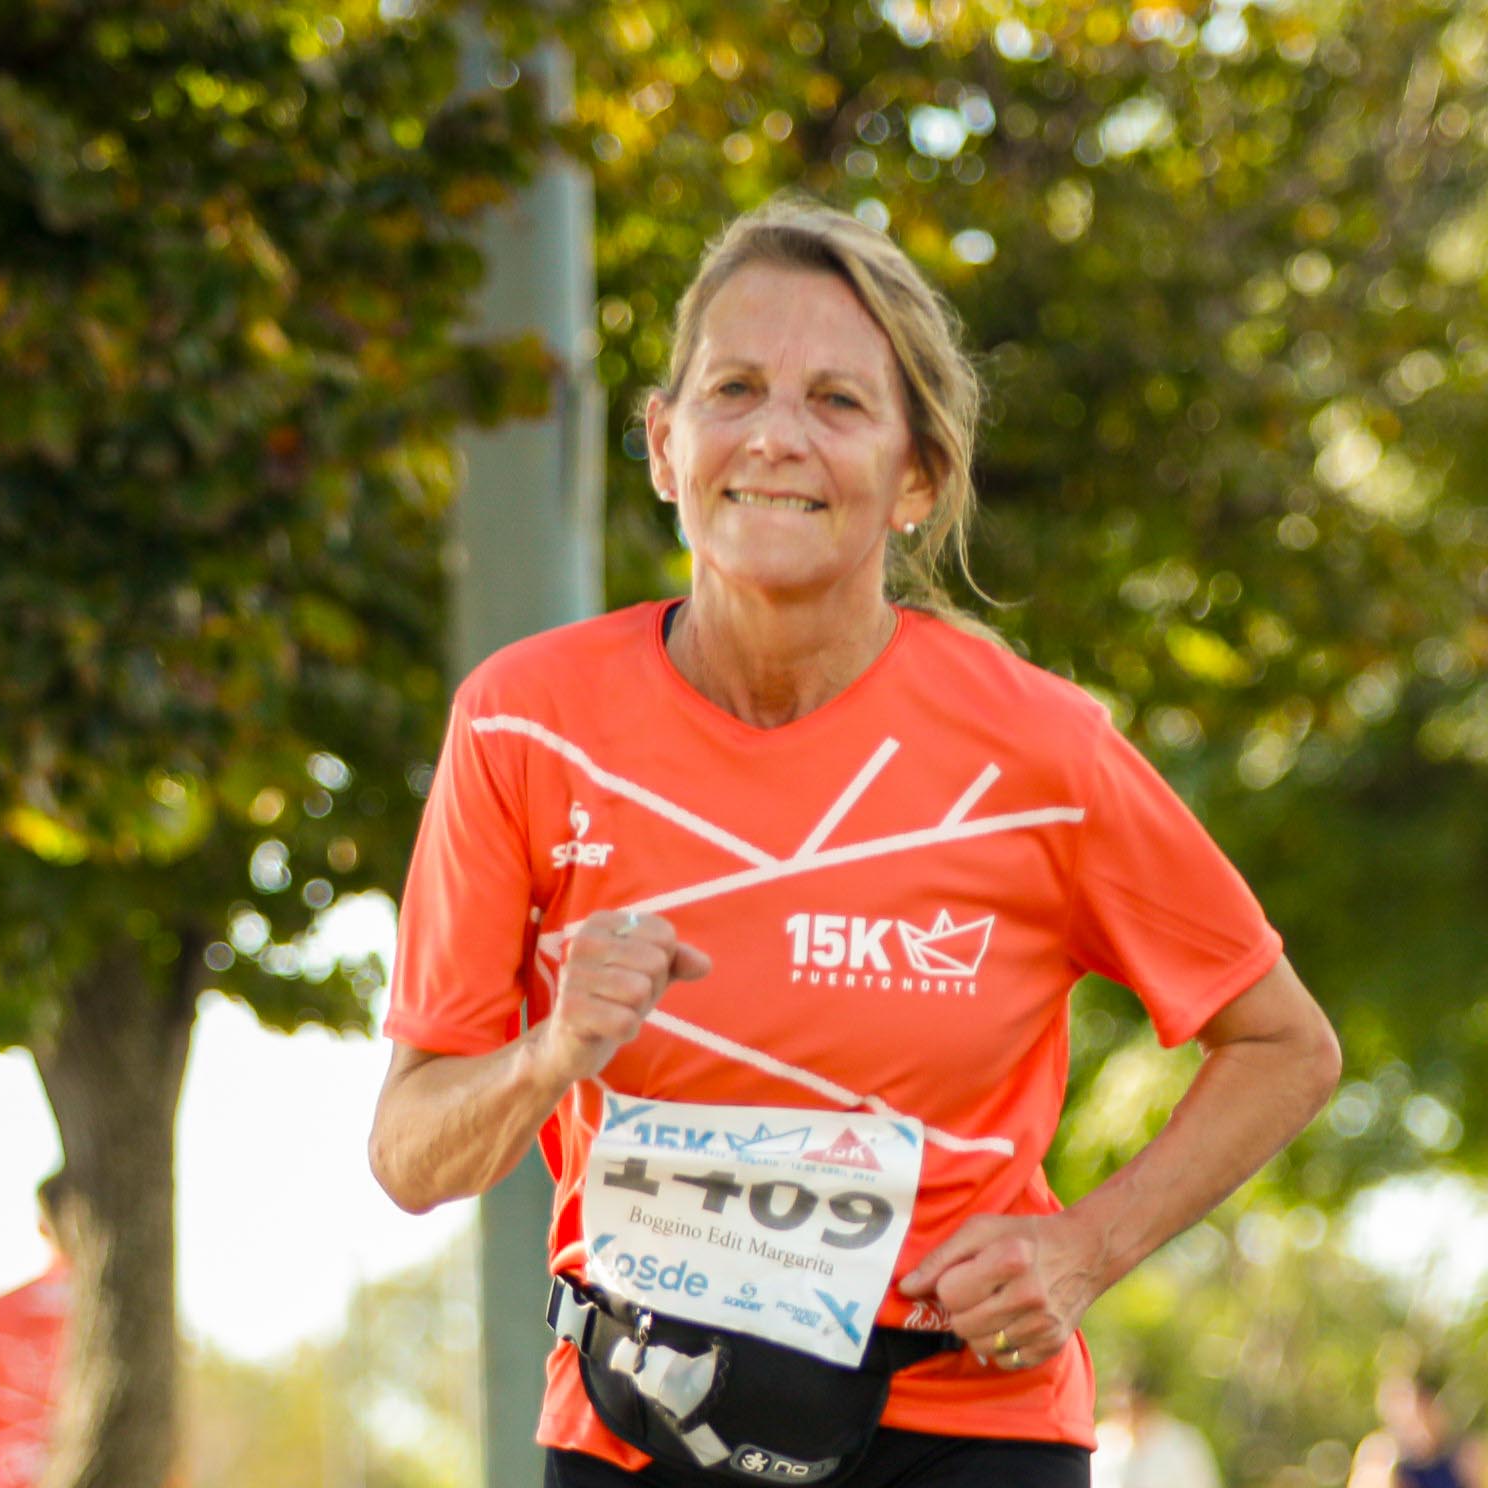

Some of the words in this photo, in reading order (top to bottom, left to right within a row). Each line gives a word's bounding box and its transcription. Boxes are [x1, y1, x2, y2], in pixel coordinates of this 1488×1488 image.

[786, 913, 893, 972] 15K
[791, 969, 892, 990] PUERTO
[902, 976, 977, 996] NORTE
[628, 1205, 703, 1238] Boggino
[706, 1226, 743, 1251] Edit
[747, 1236, 835, 1277] Margarita
[614, 1251, 709, 1298] osde
